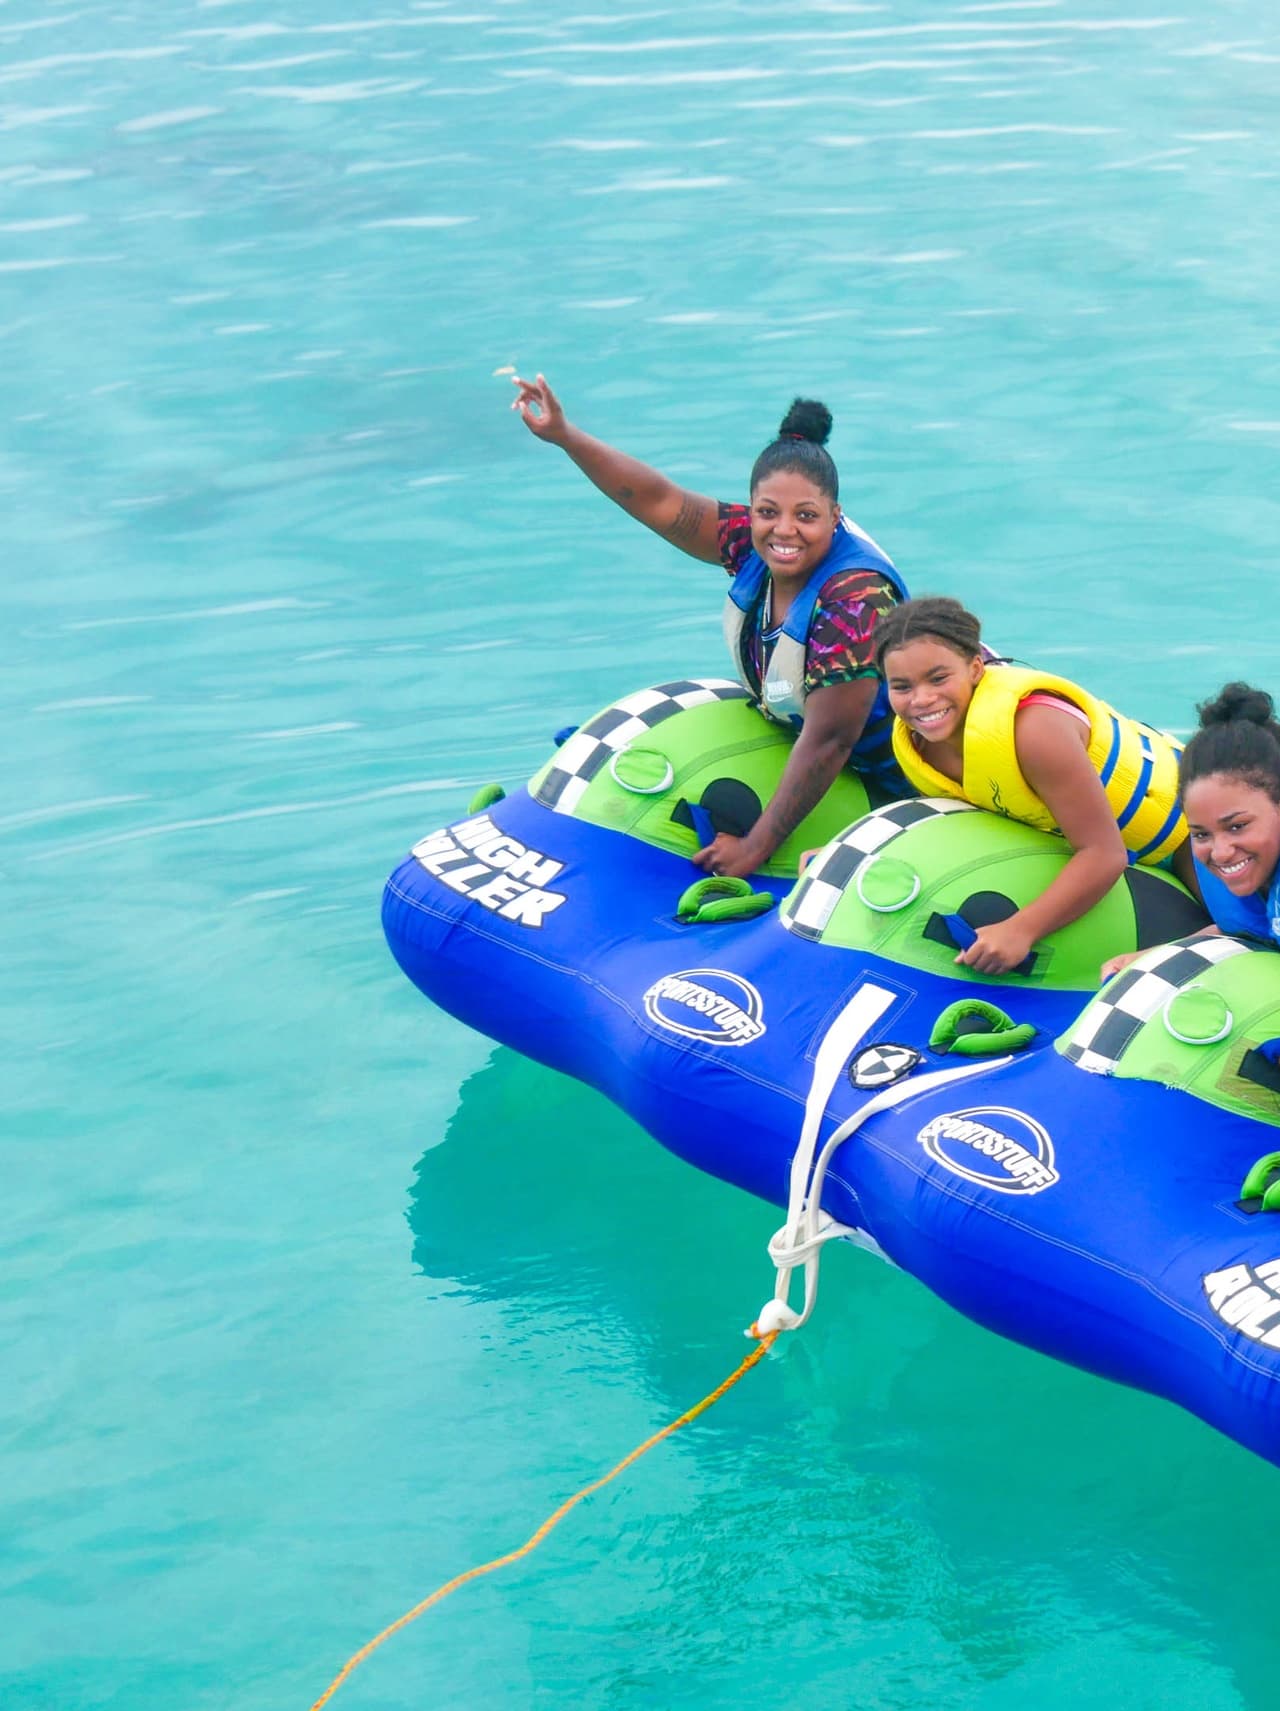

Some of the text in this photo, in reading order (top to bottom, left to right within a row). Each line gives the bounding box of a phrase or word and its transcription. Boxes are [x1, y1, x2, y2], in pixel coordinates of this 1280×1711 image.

[451, 814, 565, 887] HIGH
[643, 976, 763, 1040] SPORTSSTUFF
[919, 1115, 1057, 1189] SPORTSSTUFF
